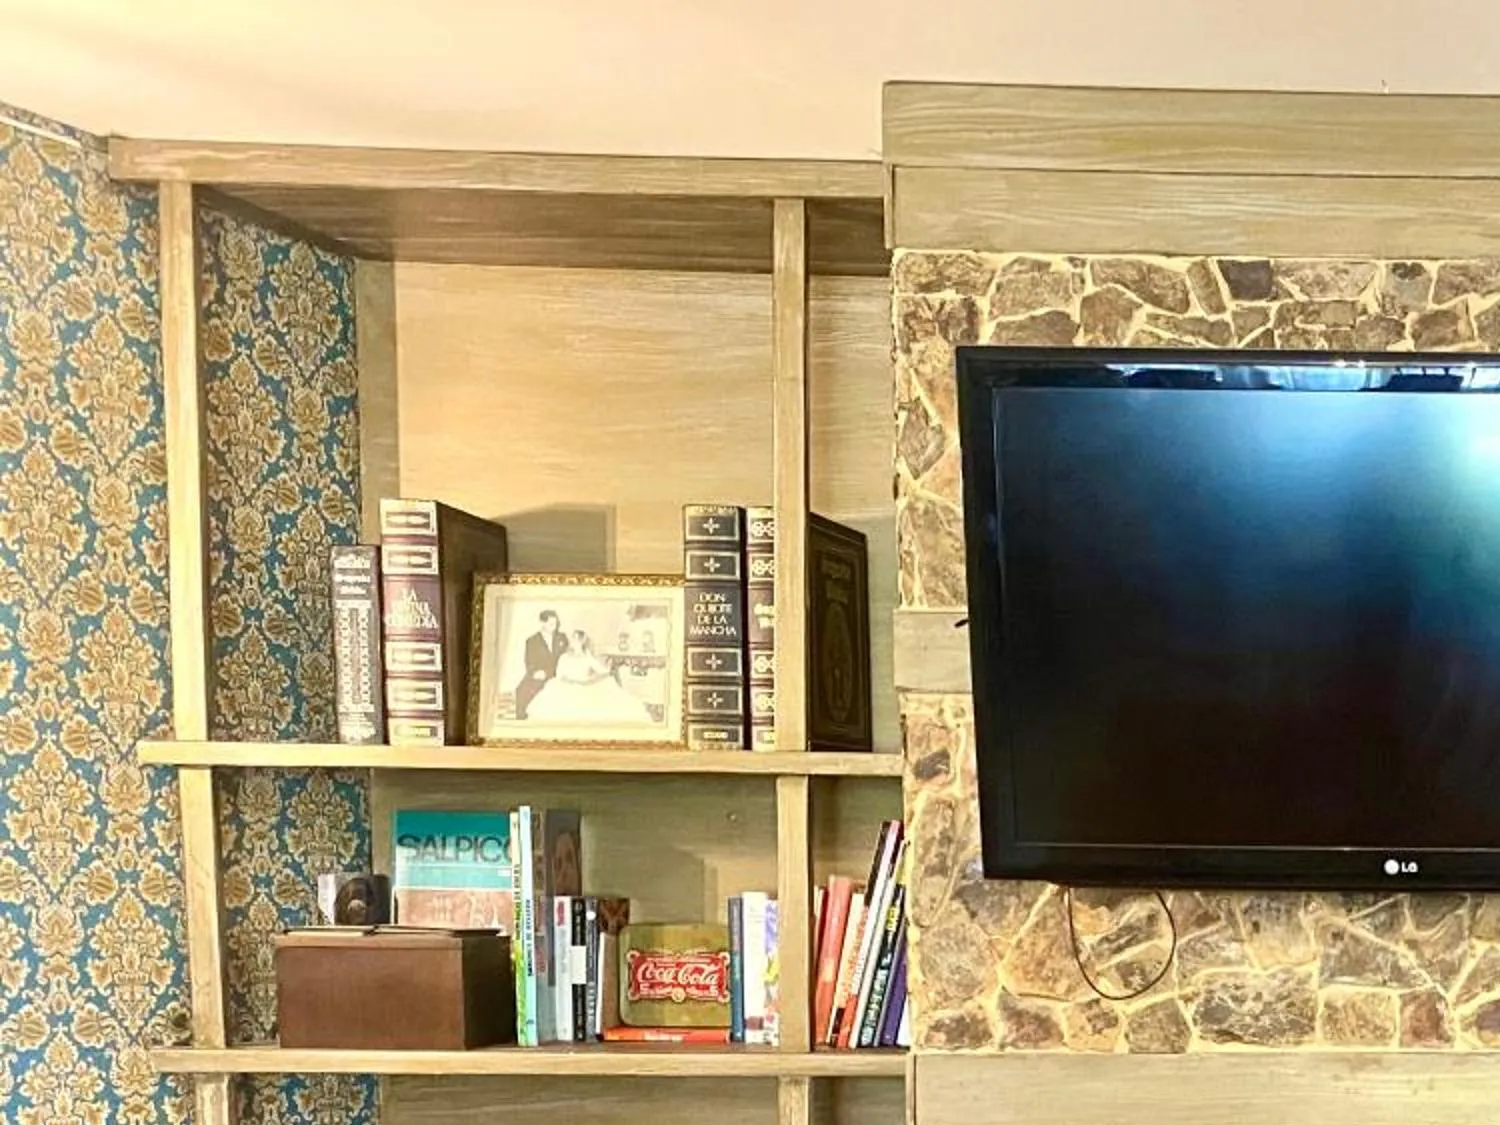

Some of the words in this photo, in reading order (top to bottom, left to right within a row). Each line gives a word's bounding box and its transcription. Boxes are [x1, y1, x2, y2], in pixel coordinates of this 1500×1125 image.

[699, 592, 726, 602] DON
[713, 614, 727, 625] LA
[689, 625, 737, 636] MANCHA
